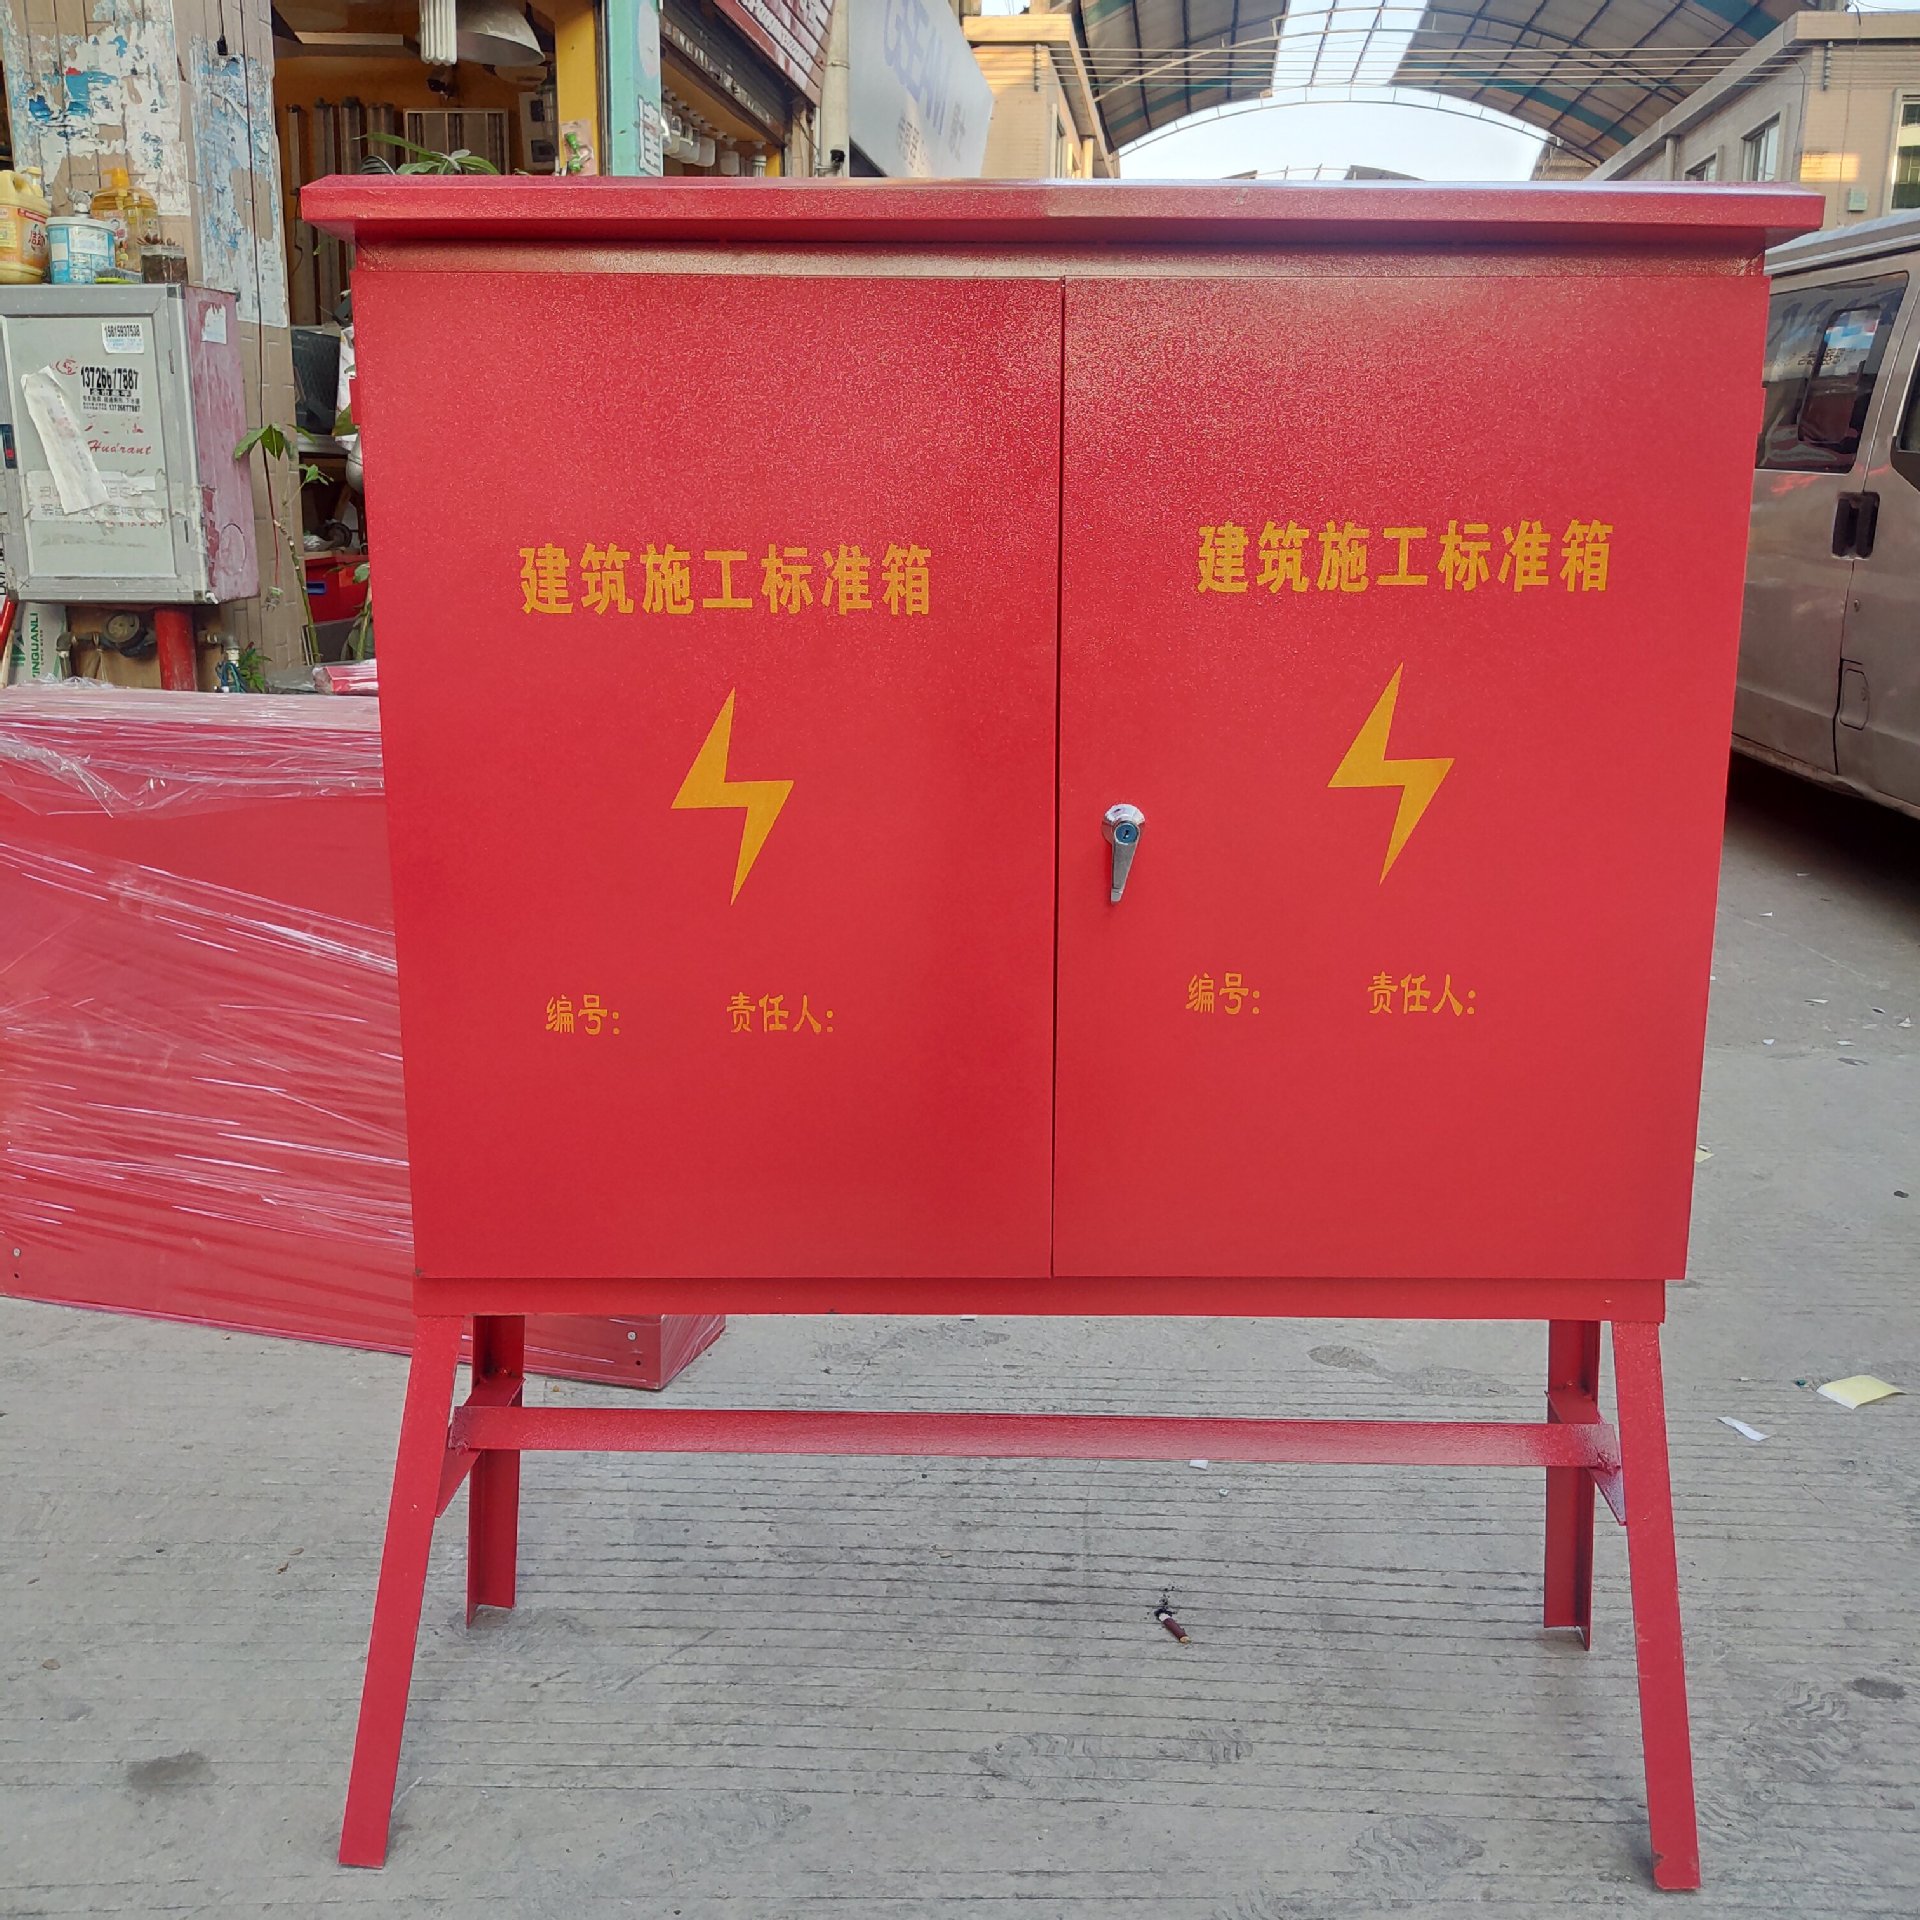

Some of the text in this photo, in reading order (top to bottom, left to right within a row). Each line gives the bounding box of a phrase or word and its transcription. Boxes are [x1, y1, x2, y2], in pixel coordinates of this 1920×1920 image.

[519, 543, 932, 616] 建筑施工标准箱
[1197, 519, 1613, 593] 建筑施工标准箱
[545, 991, 834, 1036] 编号: 责任人:
[1185, 971, 1476, 1016] 编号: 责任人:
